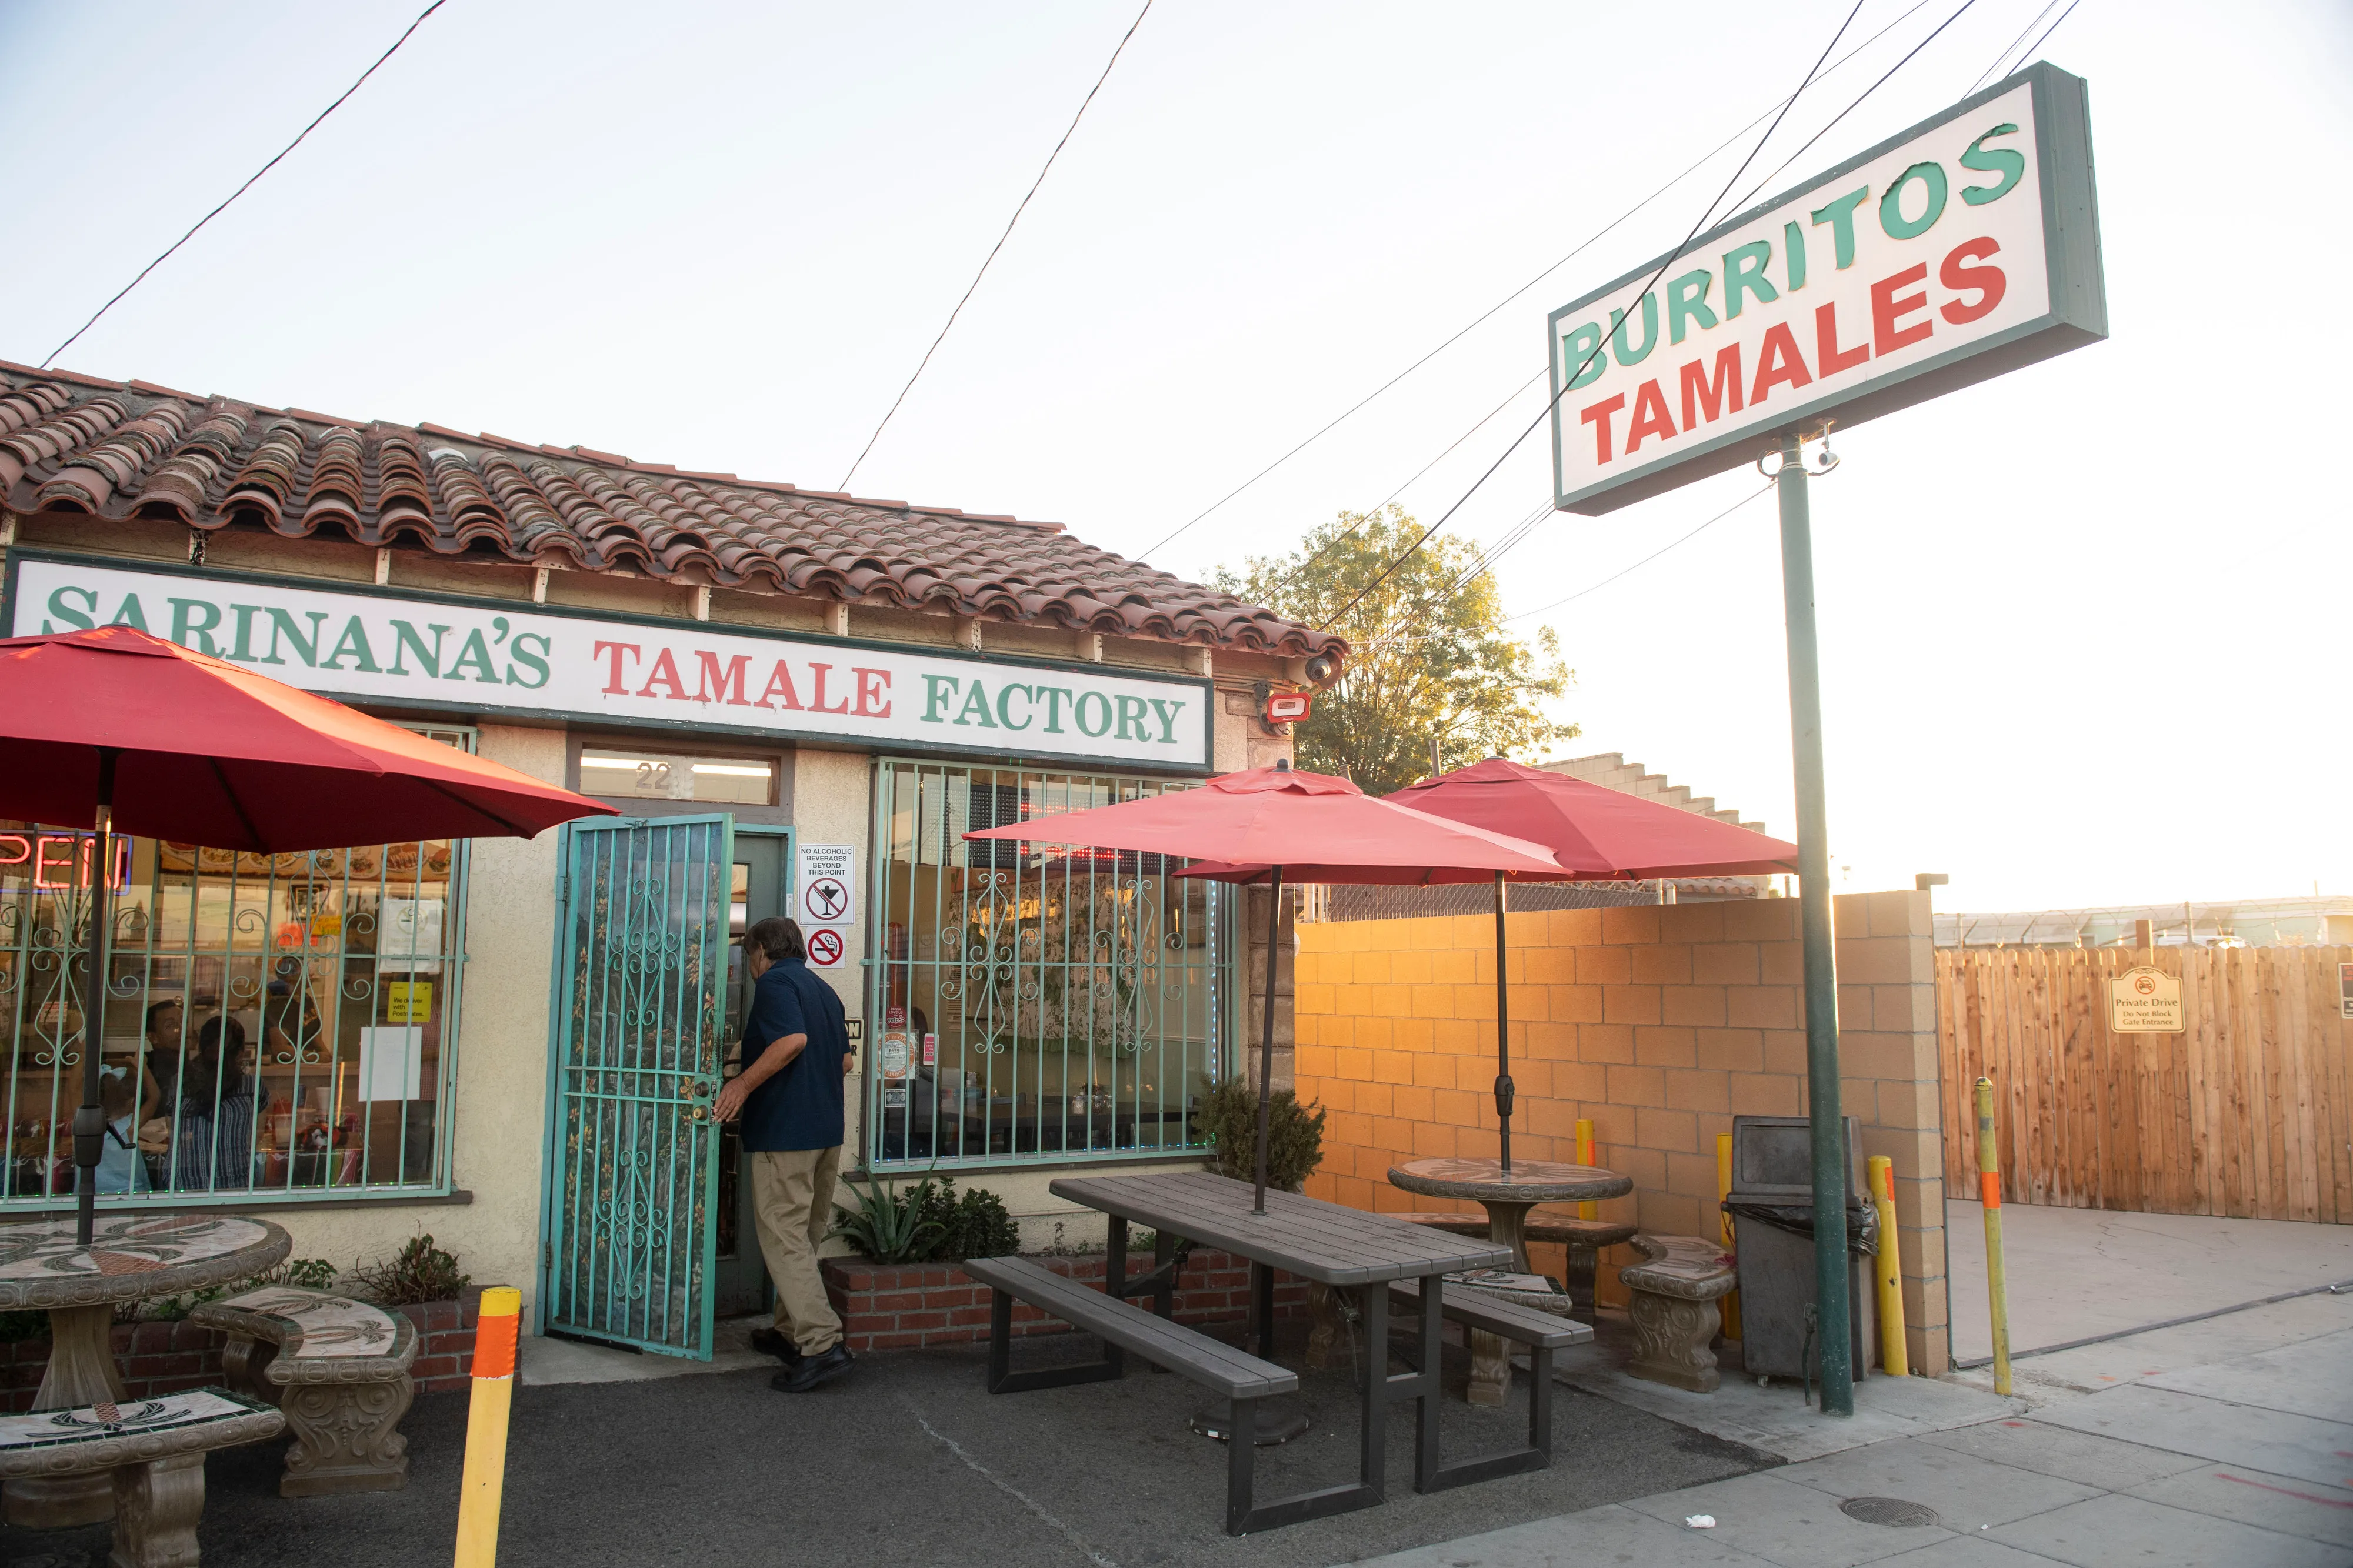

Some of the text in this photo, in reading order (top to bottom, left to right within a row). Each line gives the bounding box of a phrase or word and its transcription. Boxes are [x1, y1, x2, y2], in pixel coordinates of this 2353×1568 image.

[1562, 122, 2025, 391] BURRITOS
[1581, 236, 2007, 466] TAMALES
[41, 586, 1186, 744] SARINANA'S TAMALE FACTORY
[636, 762, 670, 790] 22
[2152, 998, 2178, 1006] Drive
